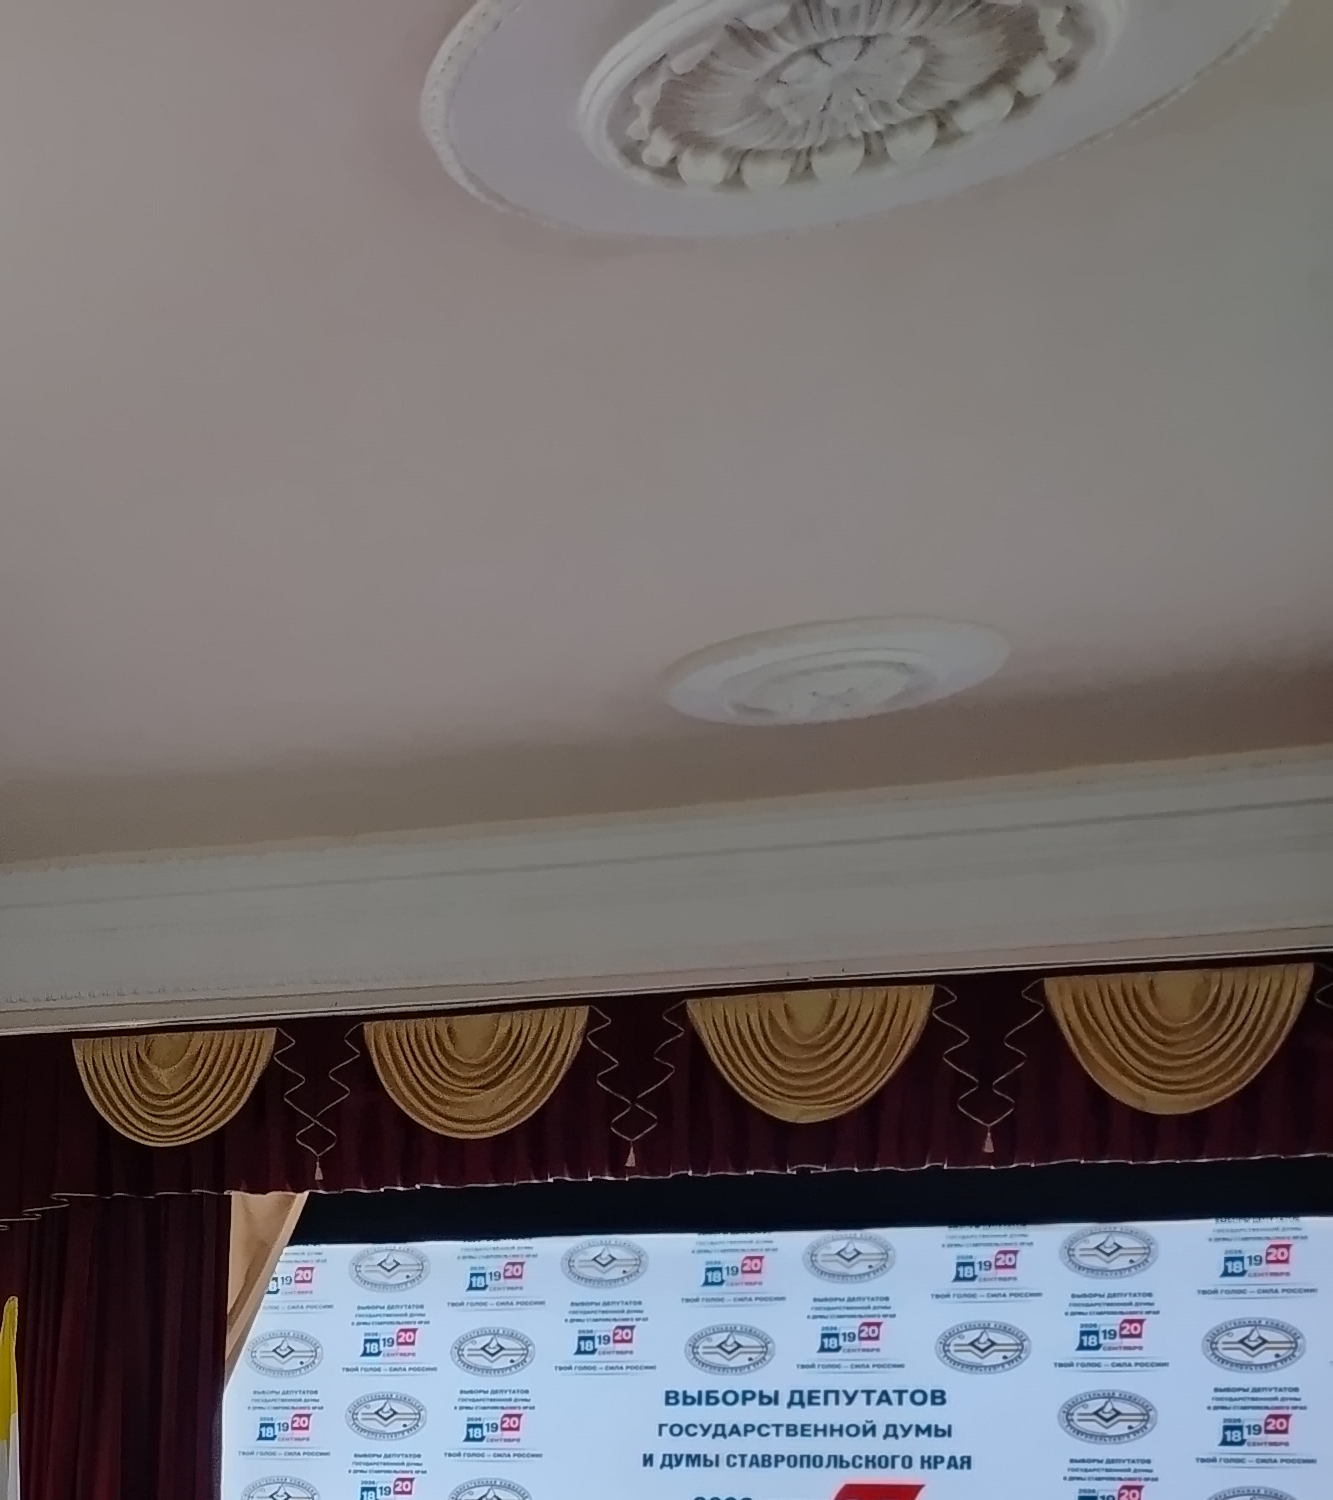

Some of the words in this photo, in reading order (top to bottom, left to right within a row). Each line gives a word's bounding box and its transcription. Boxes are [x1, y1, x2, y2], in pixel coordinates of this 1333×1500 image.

[957, 1266, 974, 1278] 18
[978, 1261, 992, 1271] 19
[996, 1254, 1015, 1265] 20
[1225, 1261, 1243, 1273] 18
[1247, 1255, 1263, 1266] 19
[1267, 1248, 1288, 1260] 20
[364, 1343, 378, 1353] 18
[382, 1338, 394, 1347] 19
[398, 1332, 414, 1342] 20
[578, 1340, 593, 1351] 18
[598, 1335, 610, 1345] 19
[615, 1329, 632, 1340] 20
[822, 1337, 838, 1348] 18
[842, 1332, 856, 1342] 19
[860, 1326, 878, 1337] 20
[1080, 1335, 1098, 1346] 18
[1102, 1329, 1117, 1340] 19
[1121, 1323, 1141, 1335] 20
[664, 1390, 779, 1406] ВЫБОРЫ
[787, 1389, 947, 1409] ДЕПУТАТОВ
[467, 1428, 482, 1438] 18
[486, 1423, 498, 1432] 19
[502, 1418, 519, 1428] 20
[658, 1420, 876, 1439] ГОСУДАРСТВЕННОЙ
[883, 1424, 952, 1440] ДУМЫ
[1223, 1430, 1242, 1442] 18
[1246, 1424, 1262, 1435] 19
[1266, 1418, 1287, 1430] 20
[642, 1453, 654, 1468] И
[660, 1454, 720, 1470] ДУМЫ
[725, 1453, 913, 1470] СТАВРОПОЛЬСКОГО
[920, 1455, 972, 1471] КРАЯ
[1119, 1489, 1140, 1500] 20
